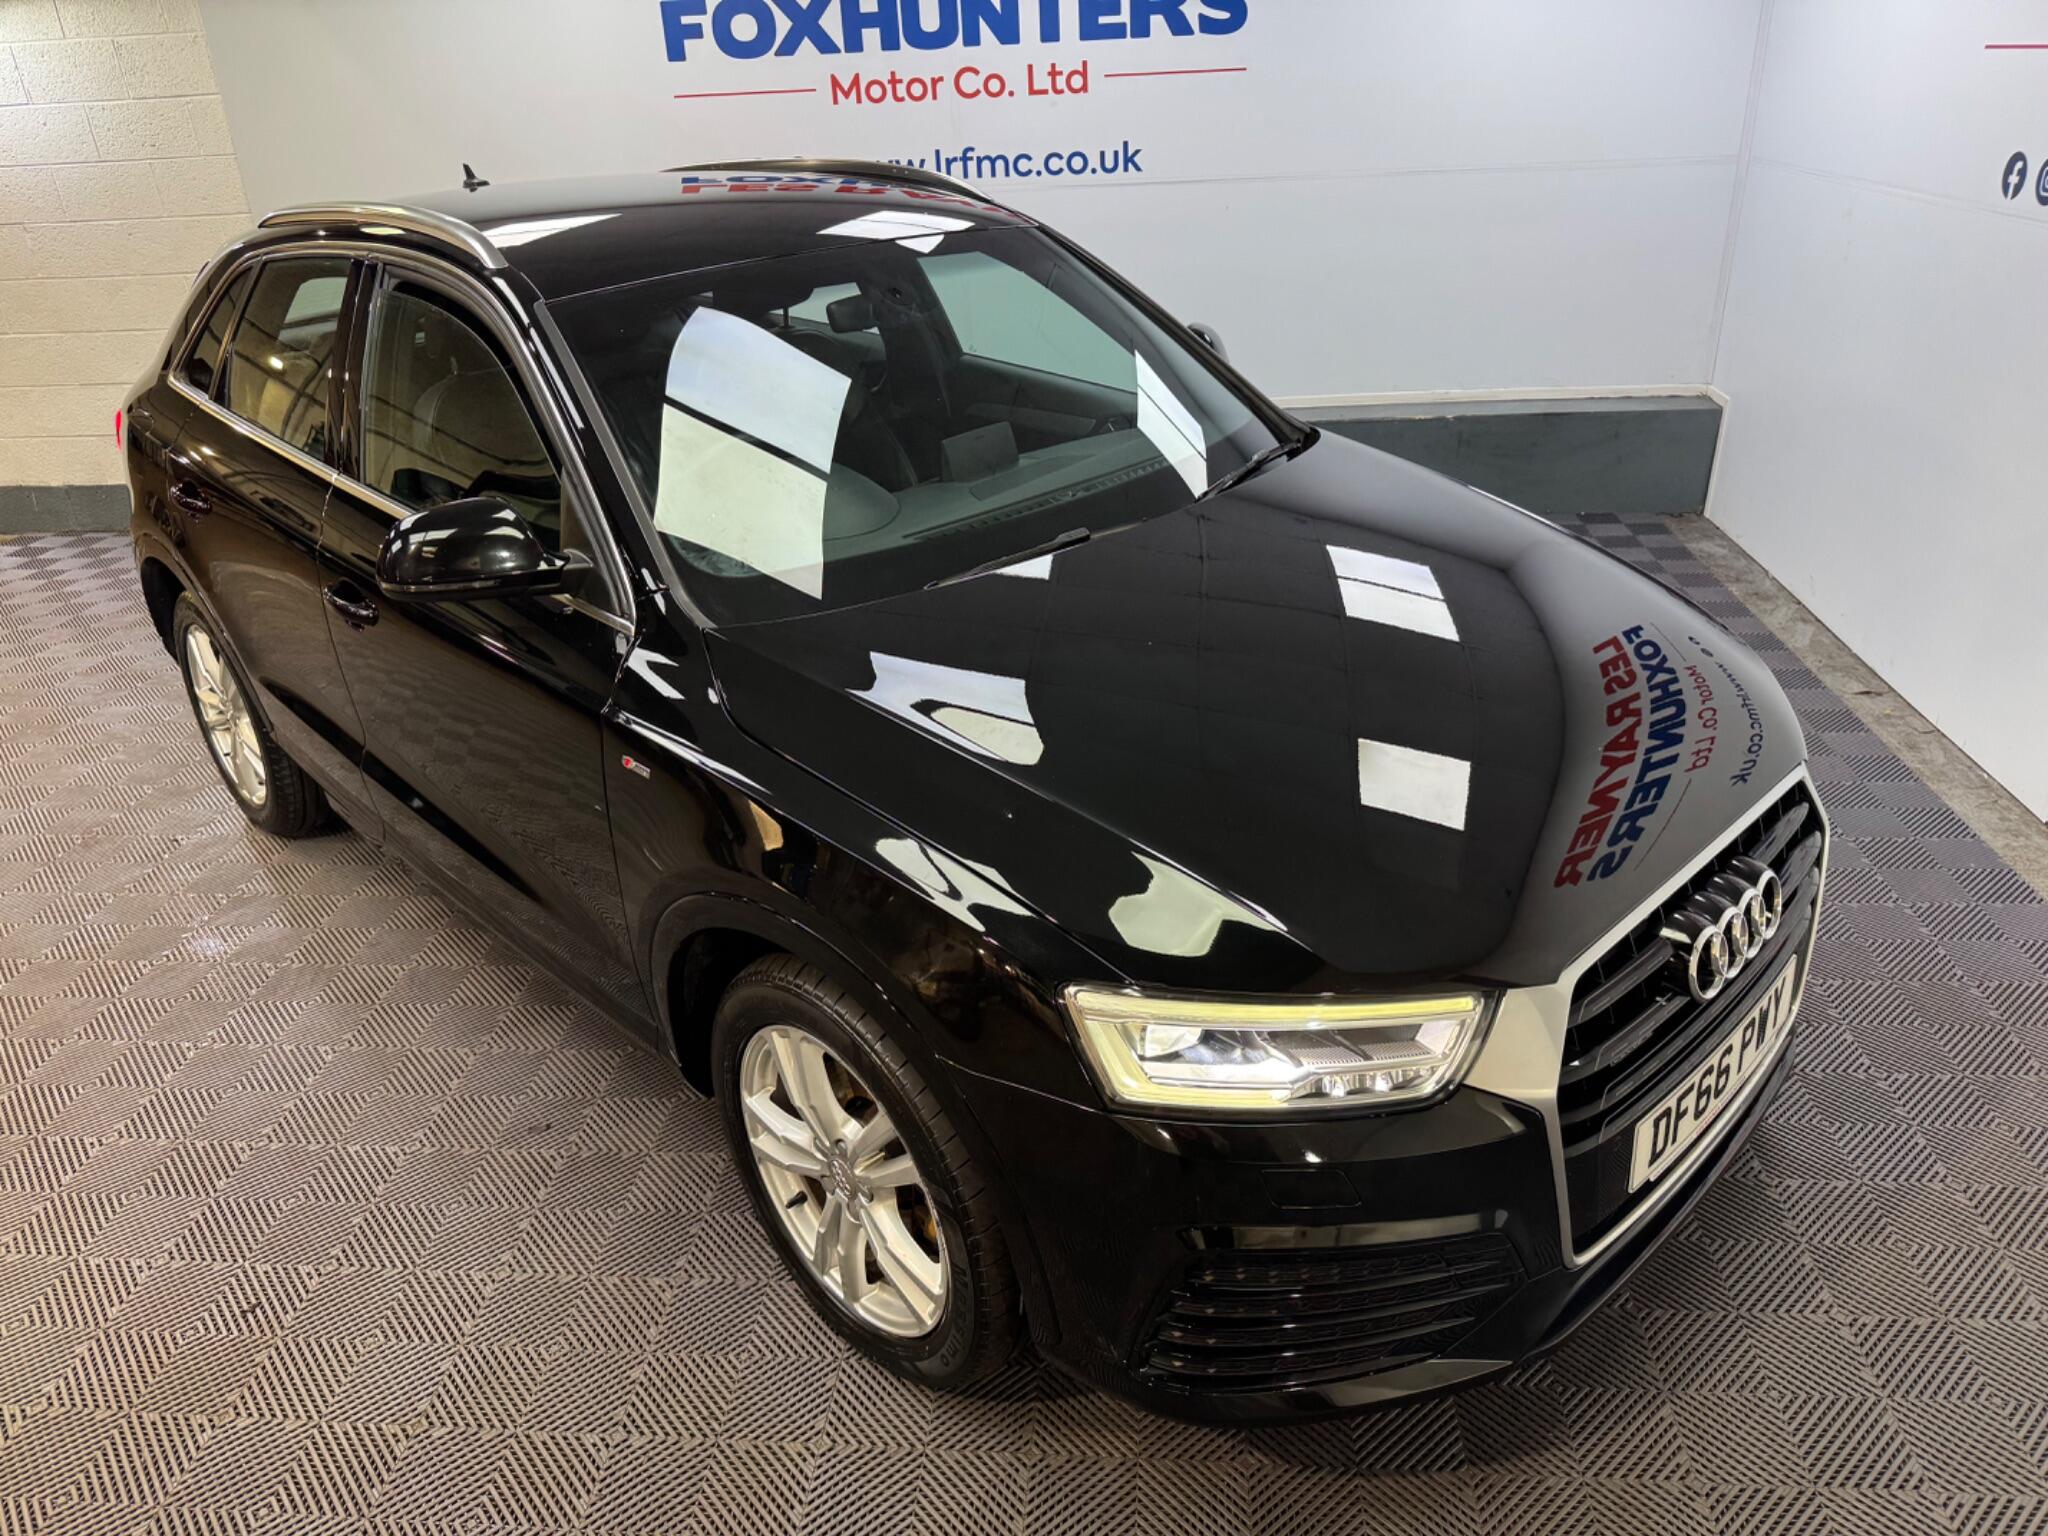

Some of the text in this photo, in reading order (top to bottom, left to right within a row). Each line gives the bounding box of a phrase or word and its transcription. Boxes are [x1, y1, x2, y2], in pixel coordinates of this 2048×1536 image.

[660, 0, 1248, 62] FOXHUNTERS
[830, 60, 1089, 105] Motor Co. Ltd
[876, 140, 1143, 179] lrfmc.co.uk
[1648, 1044, 1734, 1167] DF66
[1738, 976, 1787, 1074] PWY
